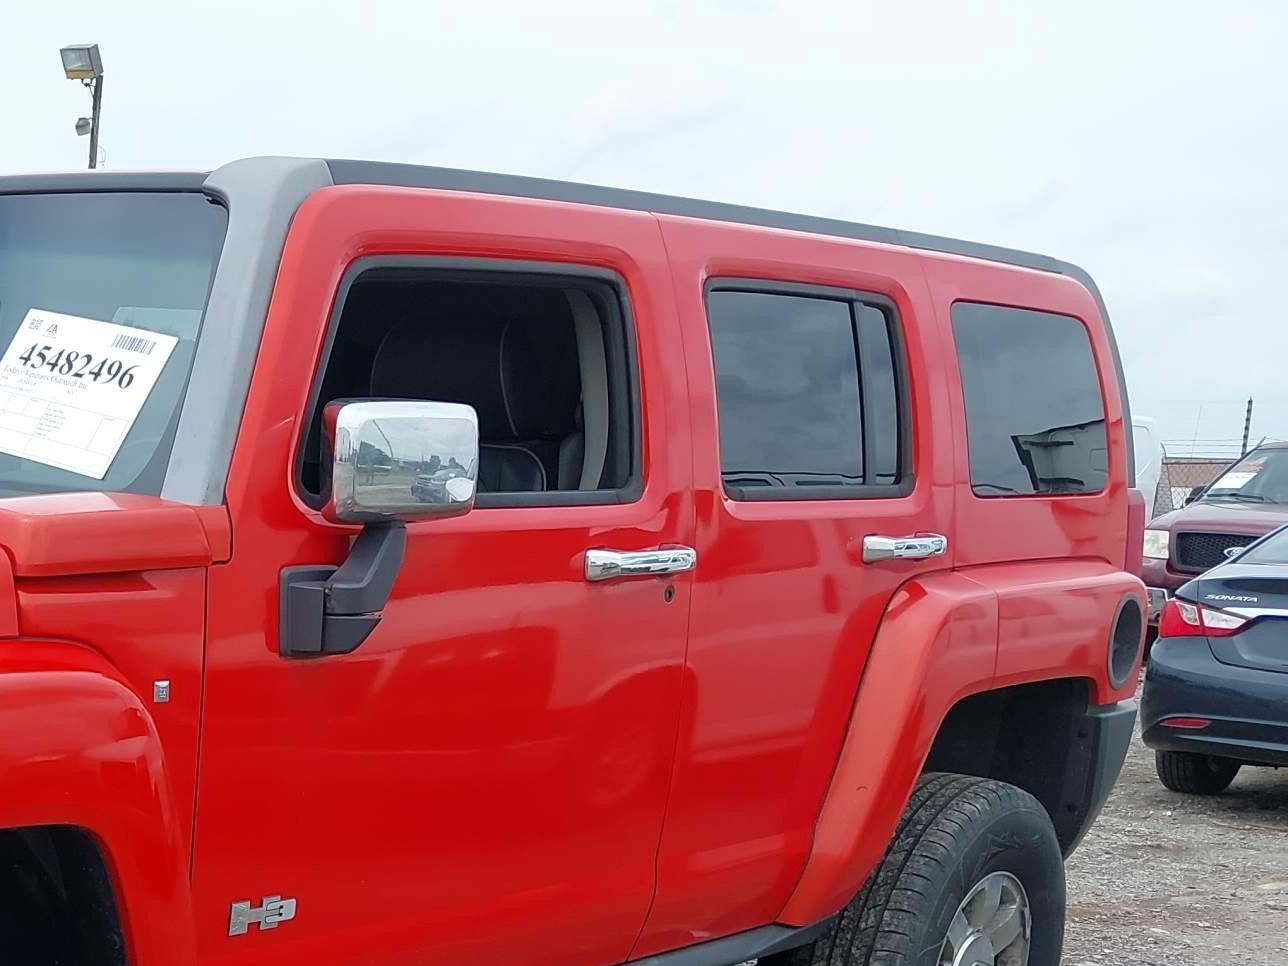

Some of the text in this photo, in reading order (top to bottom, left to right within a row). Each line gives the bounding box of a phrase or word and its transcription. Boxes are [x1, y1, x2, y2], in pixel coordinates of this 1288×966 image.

[18, 343, 141, 389] 45482496
[1205, 594, 1258, 603] SONATA
[228, 895, 296, 936] H3
